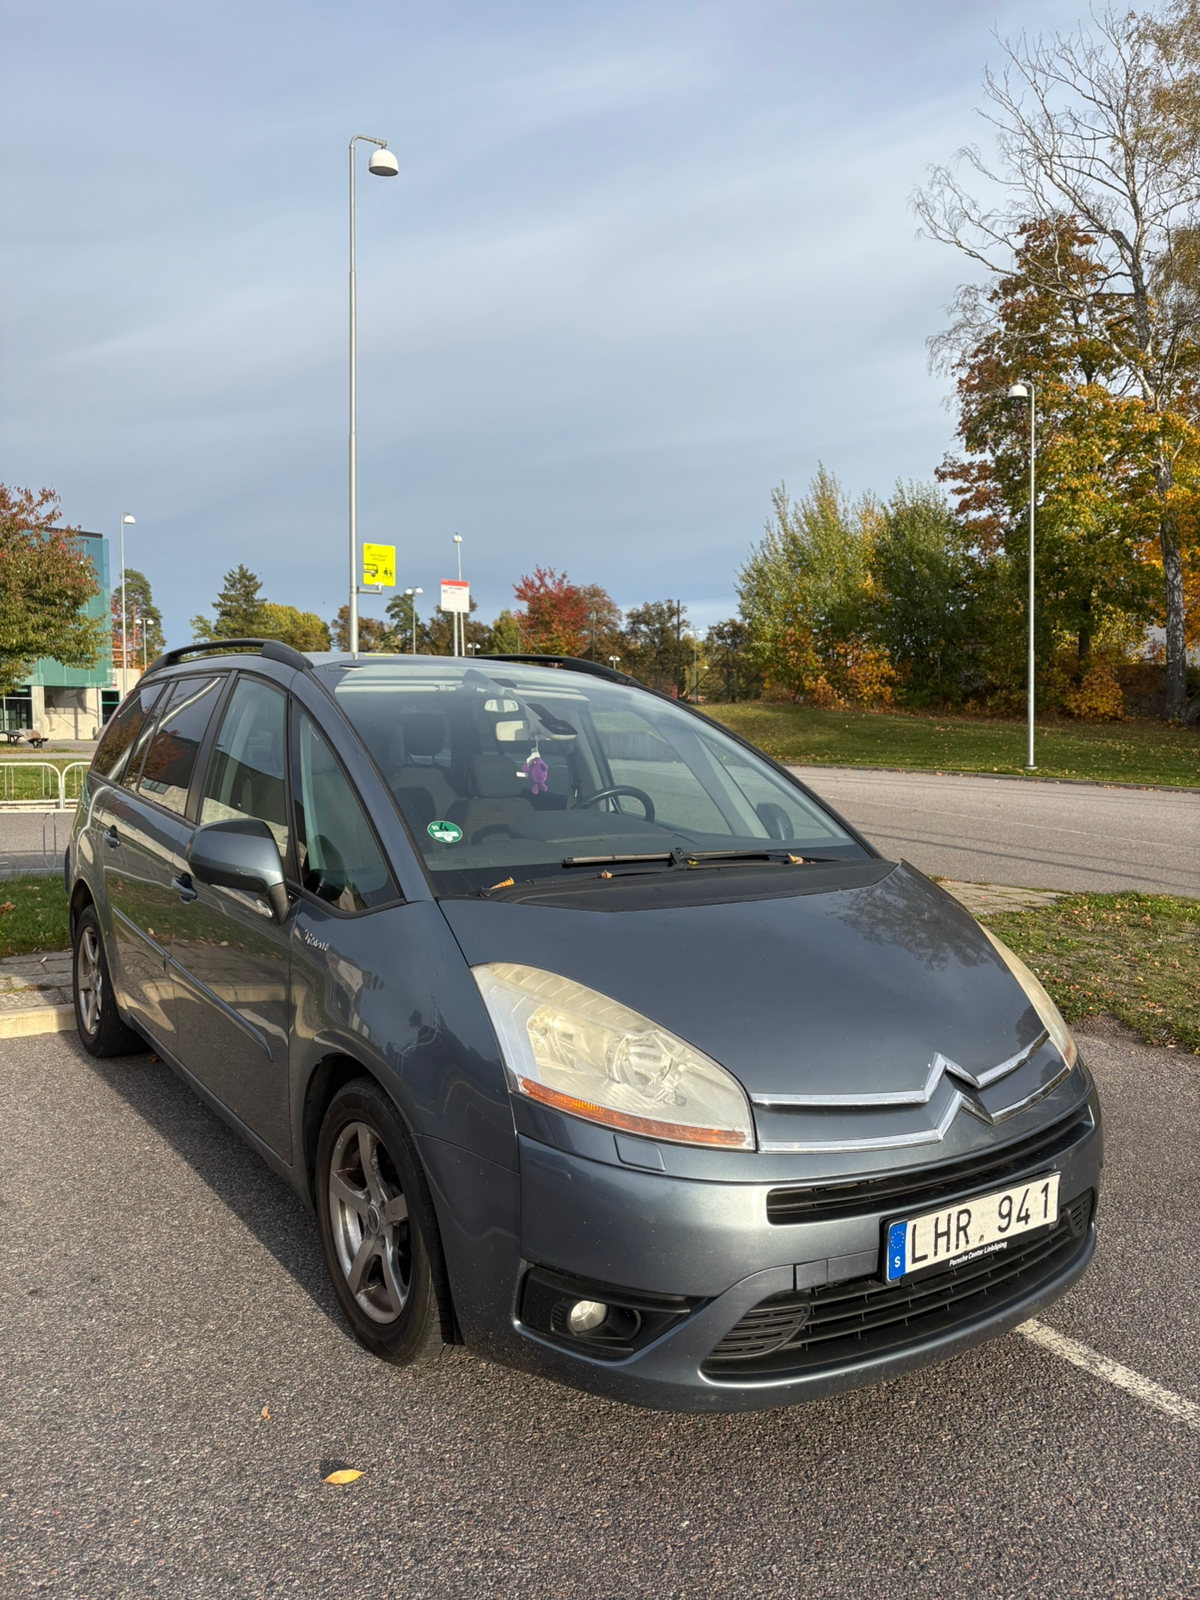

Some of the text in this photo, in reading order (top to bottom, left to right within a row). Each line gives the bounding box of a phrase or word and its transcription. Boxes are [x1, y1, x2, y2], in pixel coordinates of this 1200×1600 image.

[439, 822, 449, 832] 4
[911, 1182, 1050, 1265] LHR 941
[894, 1256, 901, 1268] S
[949, 1255, 968, 1267] Porsche
[968, 1249, 984, 1259] Center
